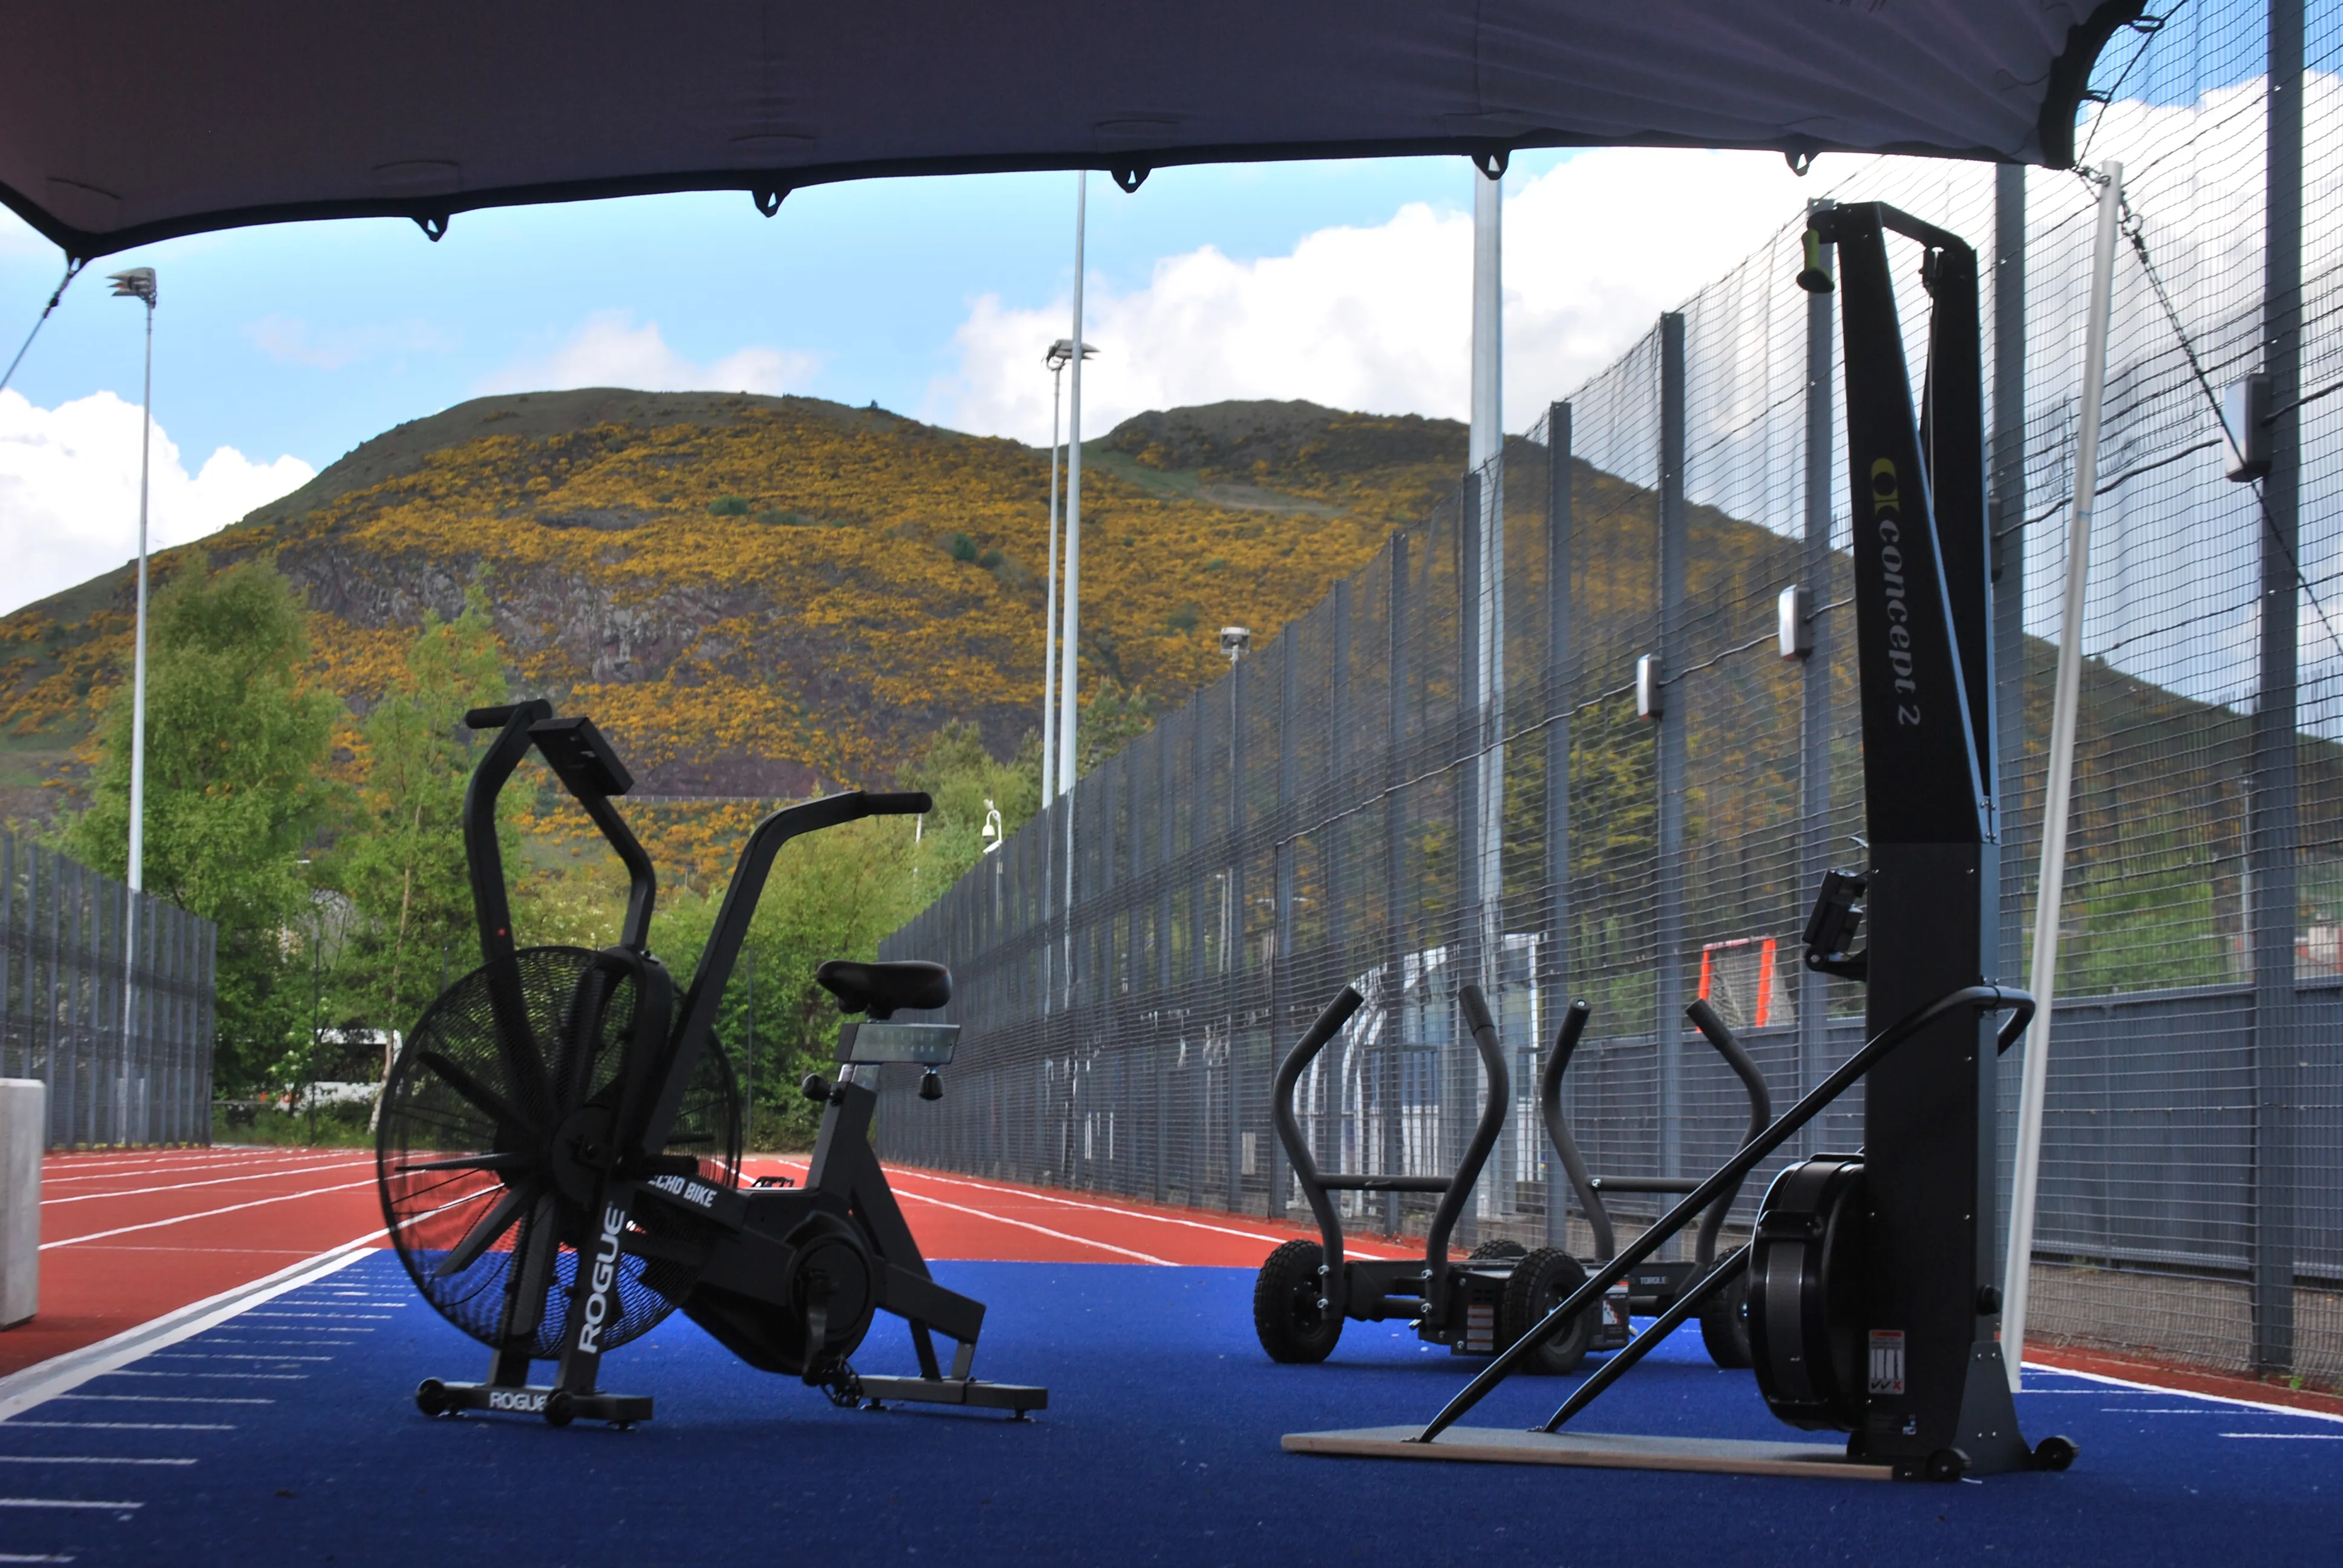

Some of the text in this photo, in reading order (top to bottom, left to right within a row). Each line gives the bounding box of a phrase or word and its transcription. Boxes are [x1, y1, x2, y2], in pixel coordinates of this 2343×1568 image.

[1879, 520, 1921, 725] concept 2
[683, 1181, 718, 1208] BIKE
[577, 1206, 626, 1354] ROGUE
